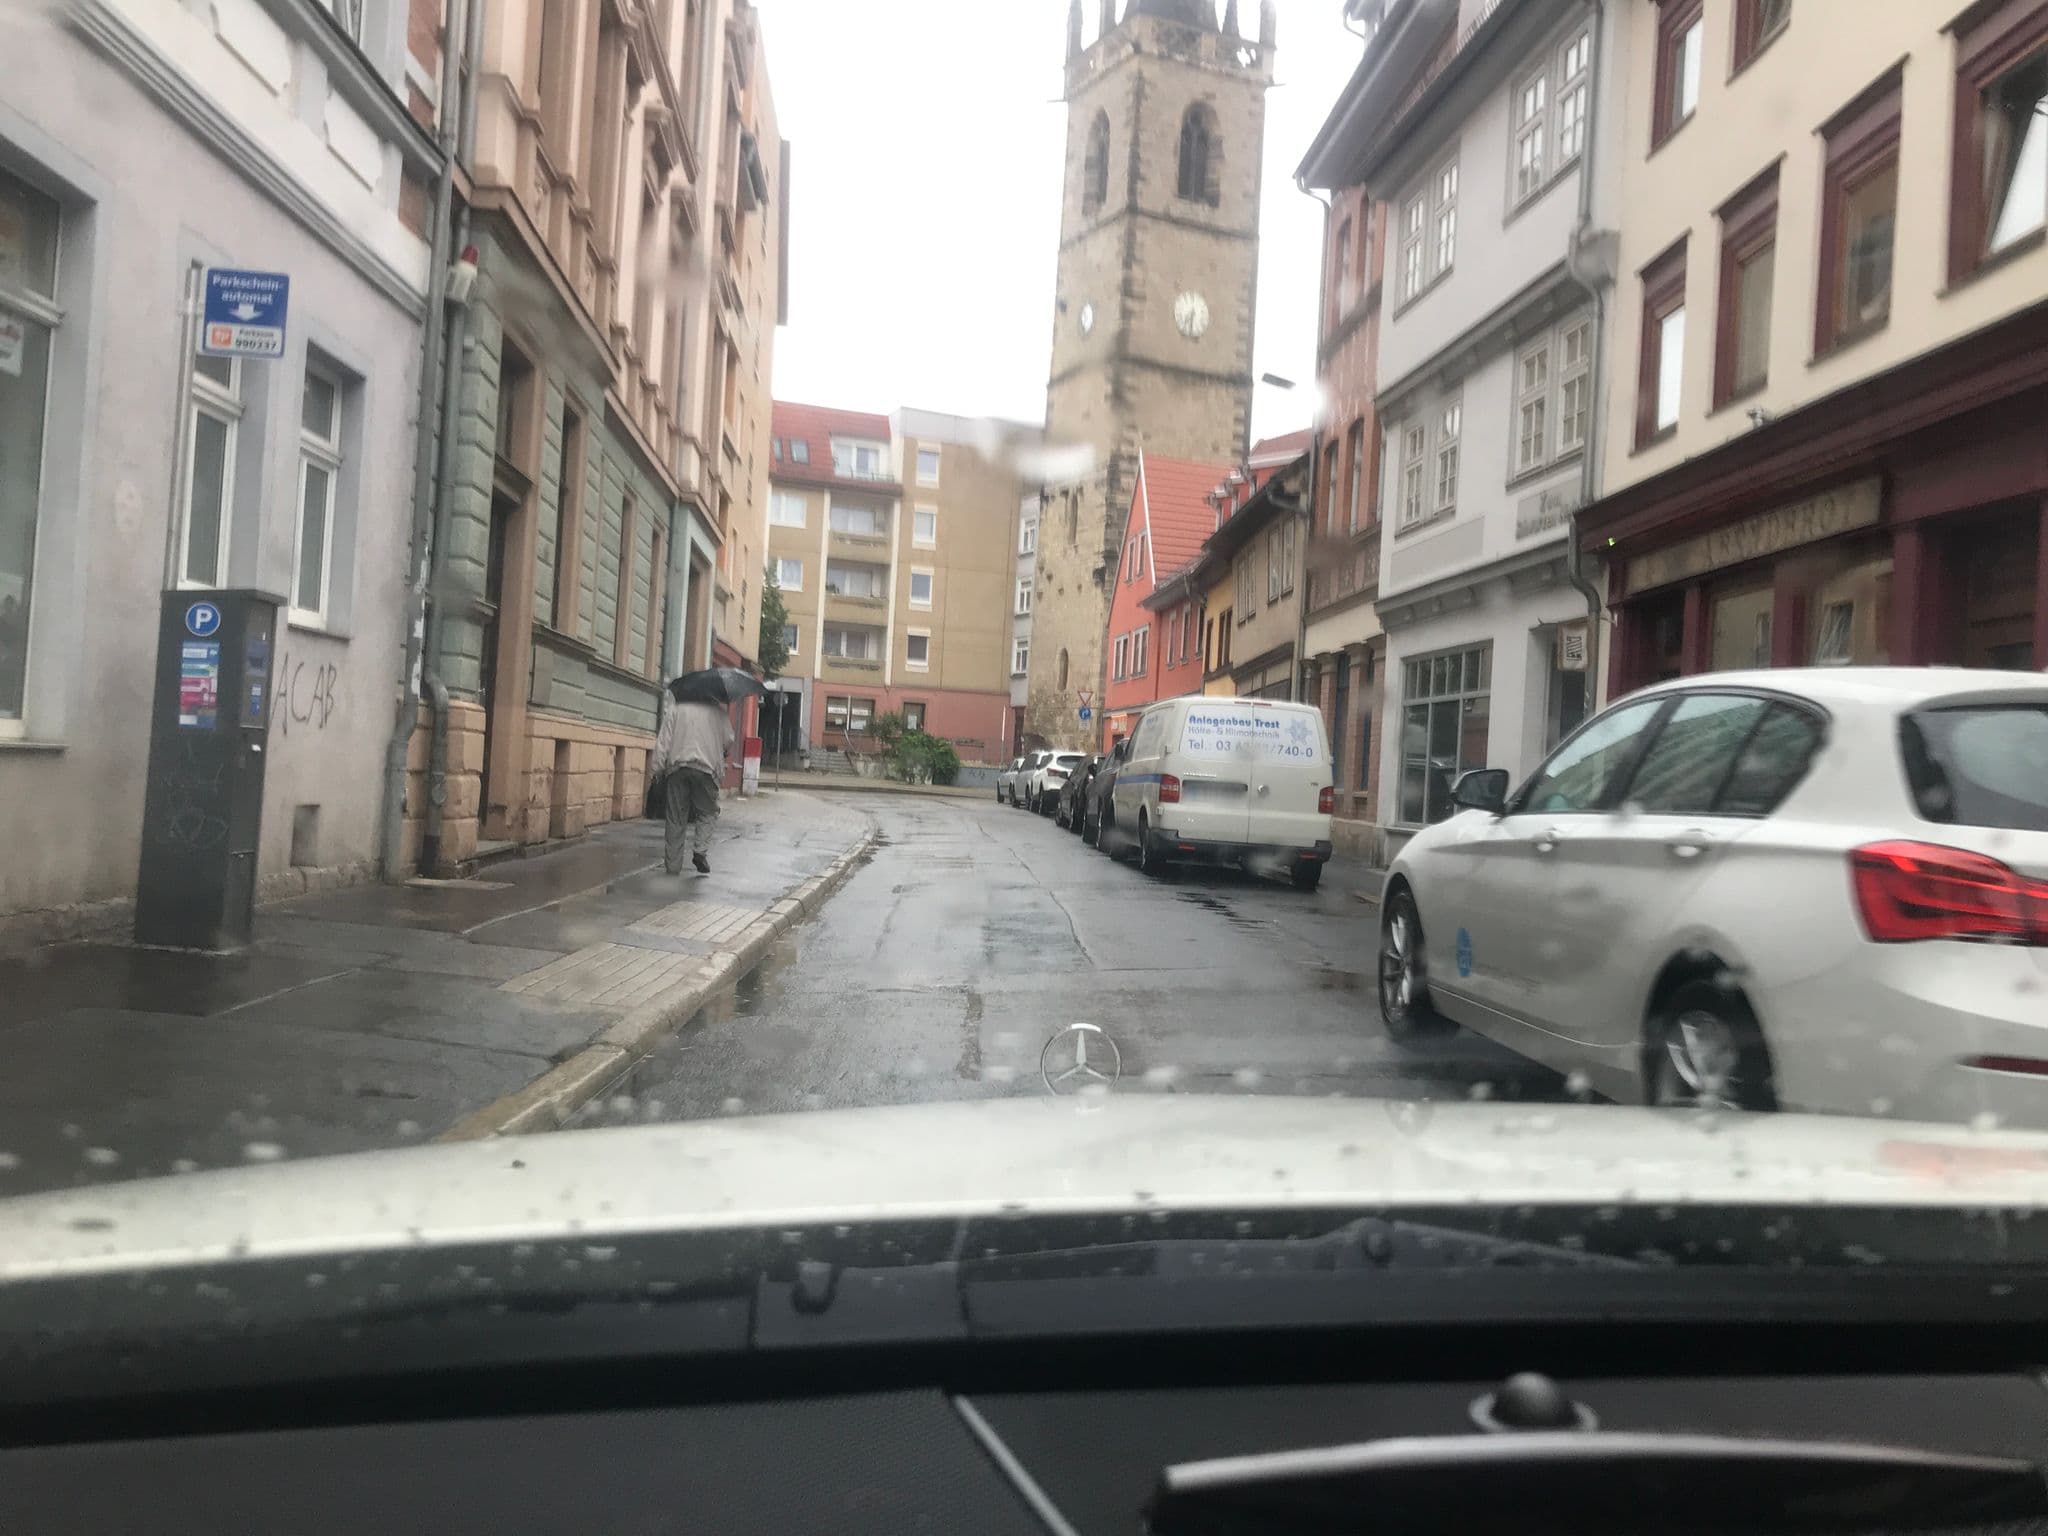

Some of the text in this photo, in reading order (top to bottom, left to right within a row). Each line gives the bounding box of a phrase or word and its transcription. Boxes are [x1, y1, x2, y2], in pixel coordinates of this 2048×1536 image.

[213, 274, 283, 291] Parkschein-
[221, 290, 273, 305] automat
[195, 609, 213, 630] P
[1188, 715, 1280, 729] Anlagenbau Trost
